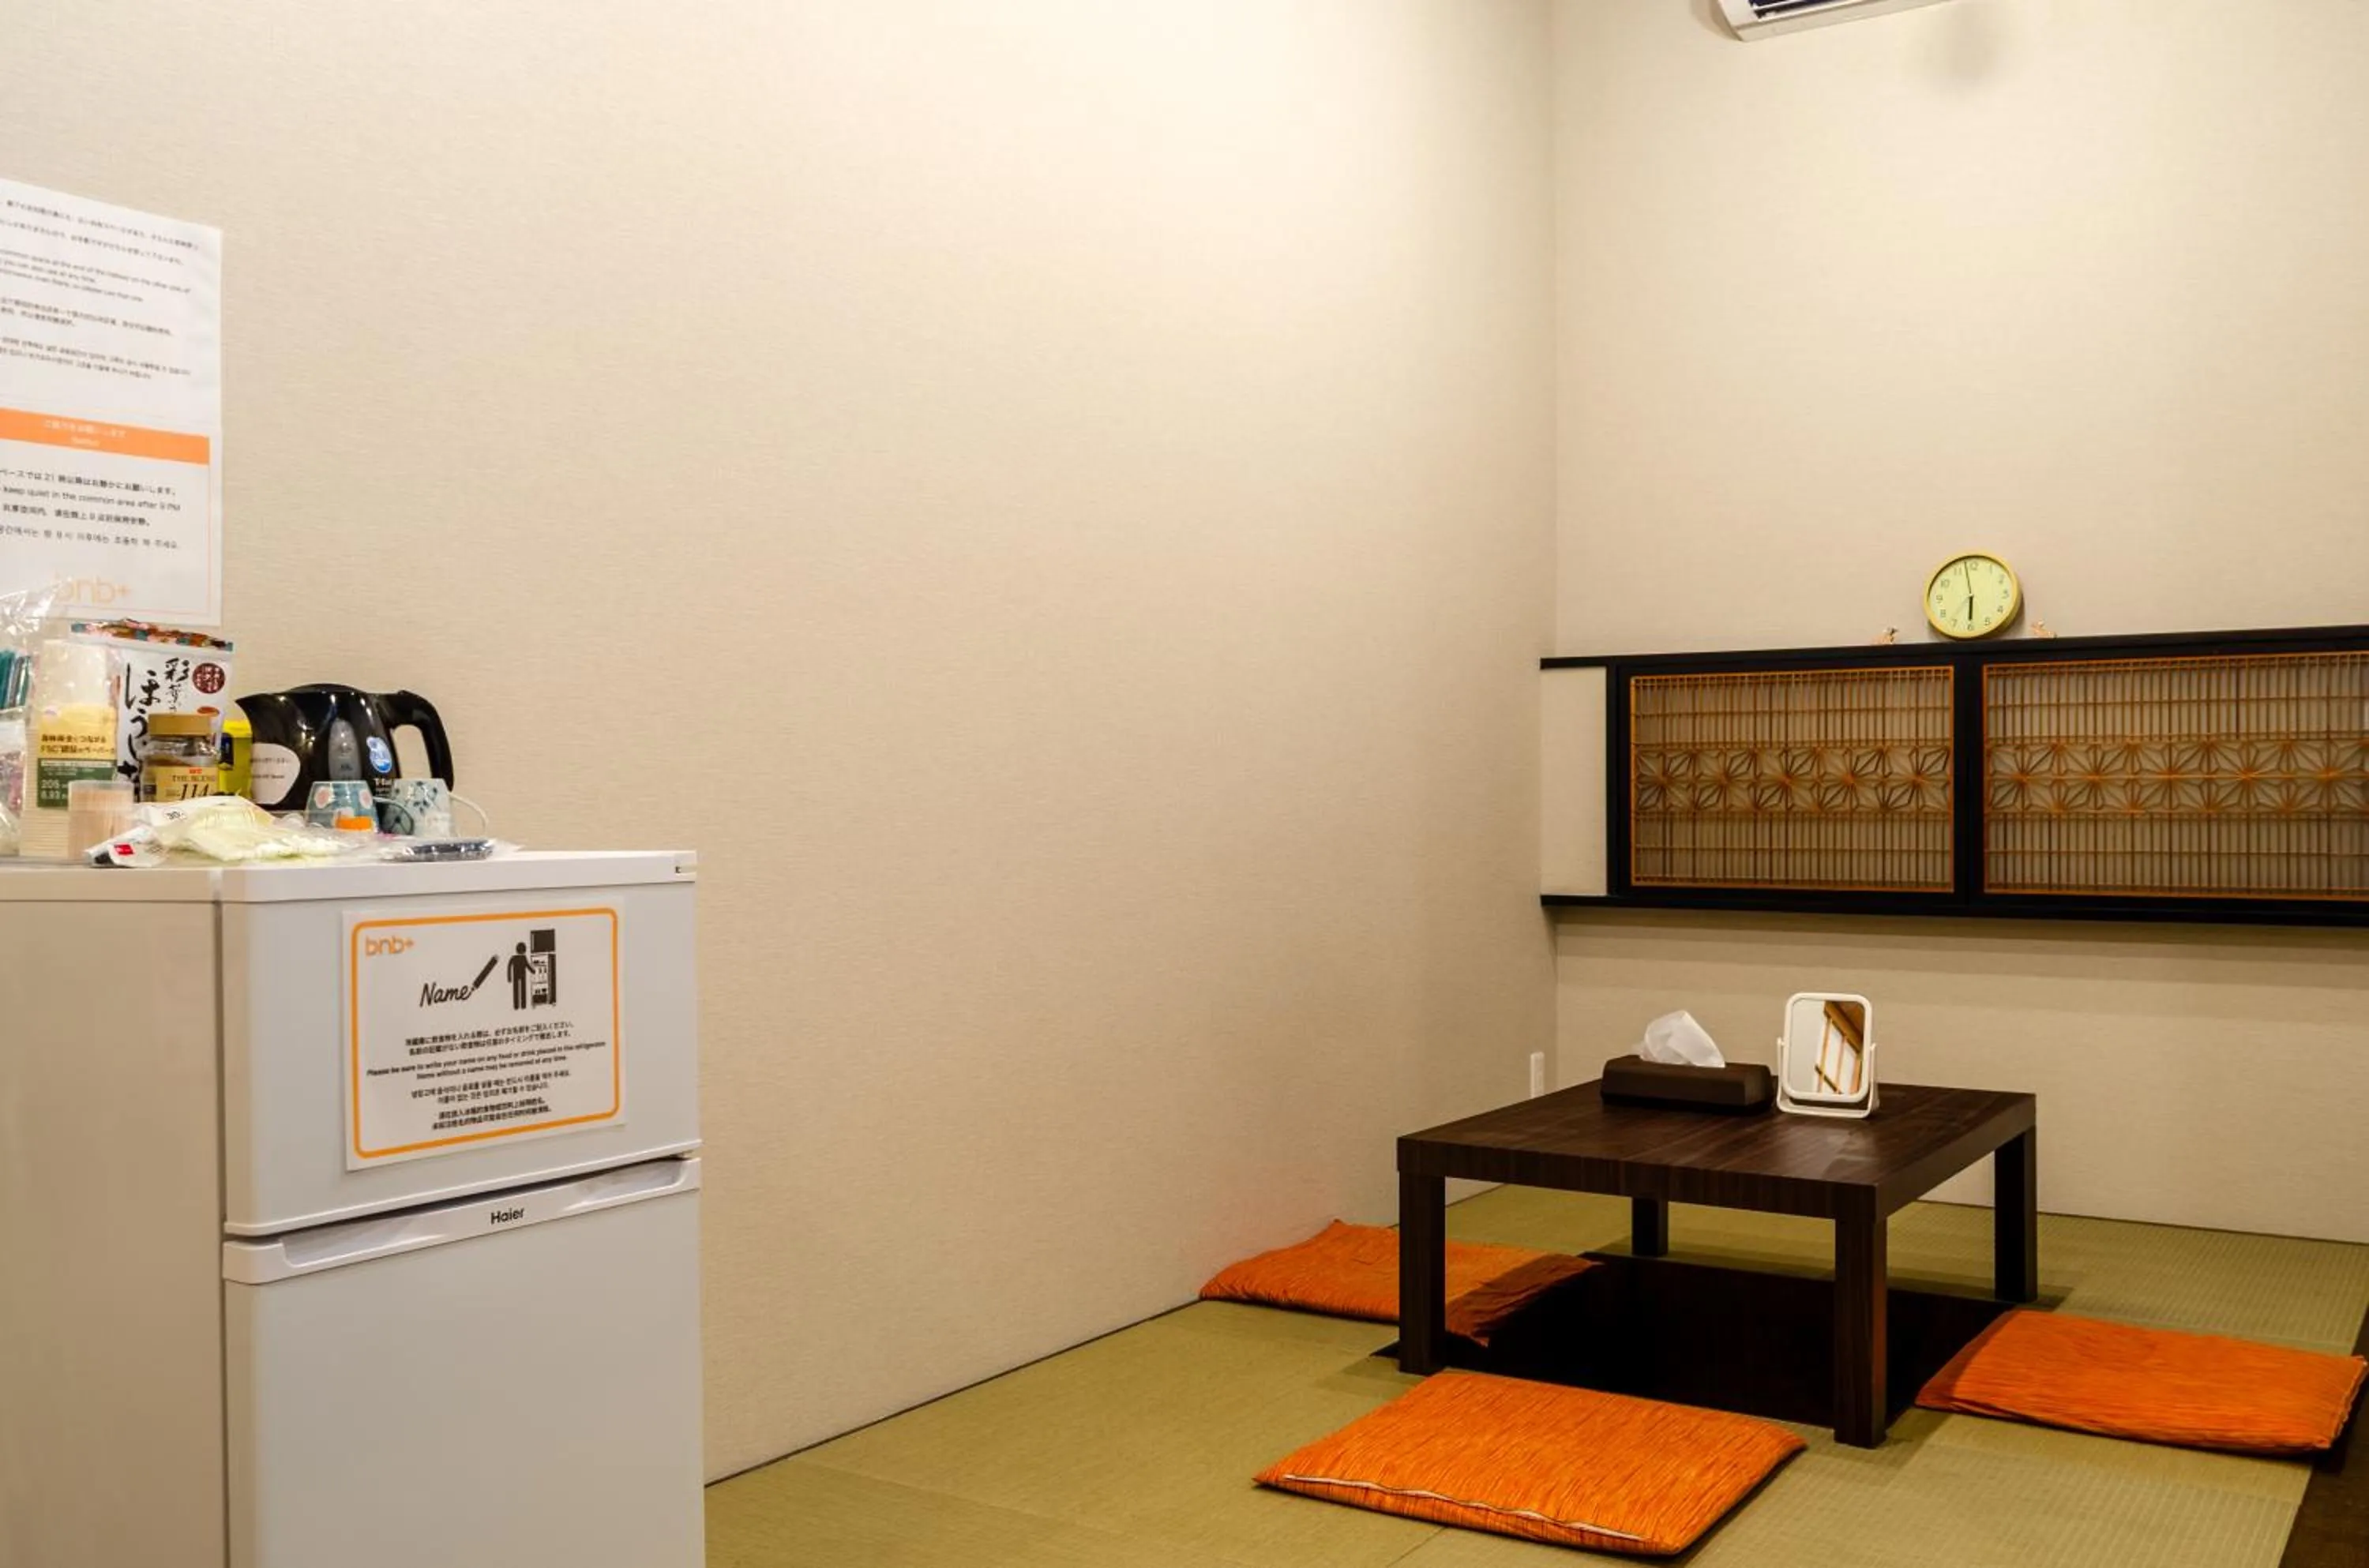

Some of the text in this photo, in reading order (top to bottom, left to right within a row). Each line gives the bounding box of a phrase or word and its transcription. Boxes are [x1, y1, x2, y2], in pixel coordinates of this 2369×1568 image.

[62, 492, 76, 501] the
[366, 936, 414, 956] bnb+
[419, 983, 471, 1007] Name
[444, 1060, 456, 1068] your
[490, 1206, 524, 1225] Haier
